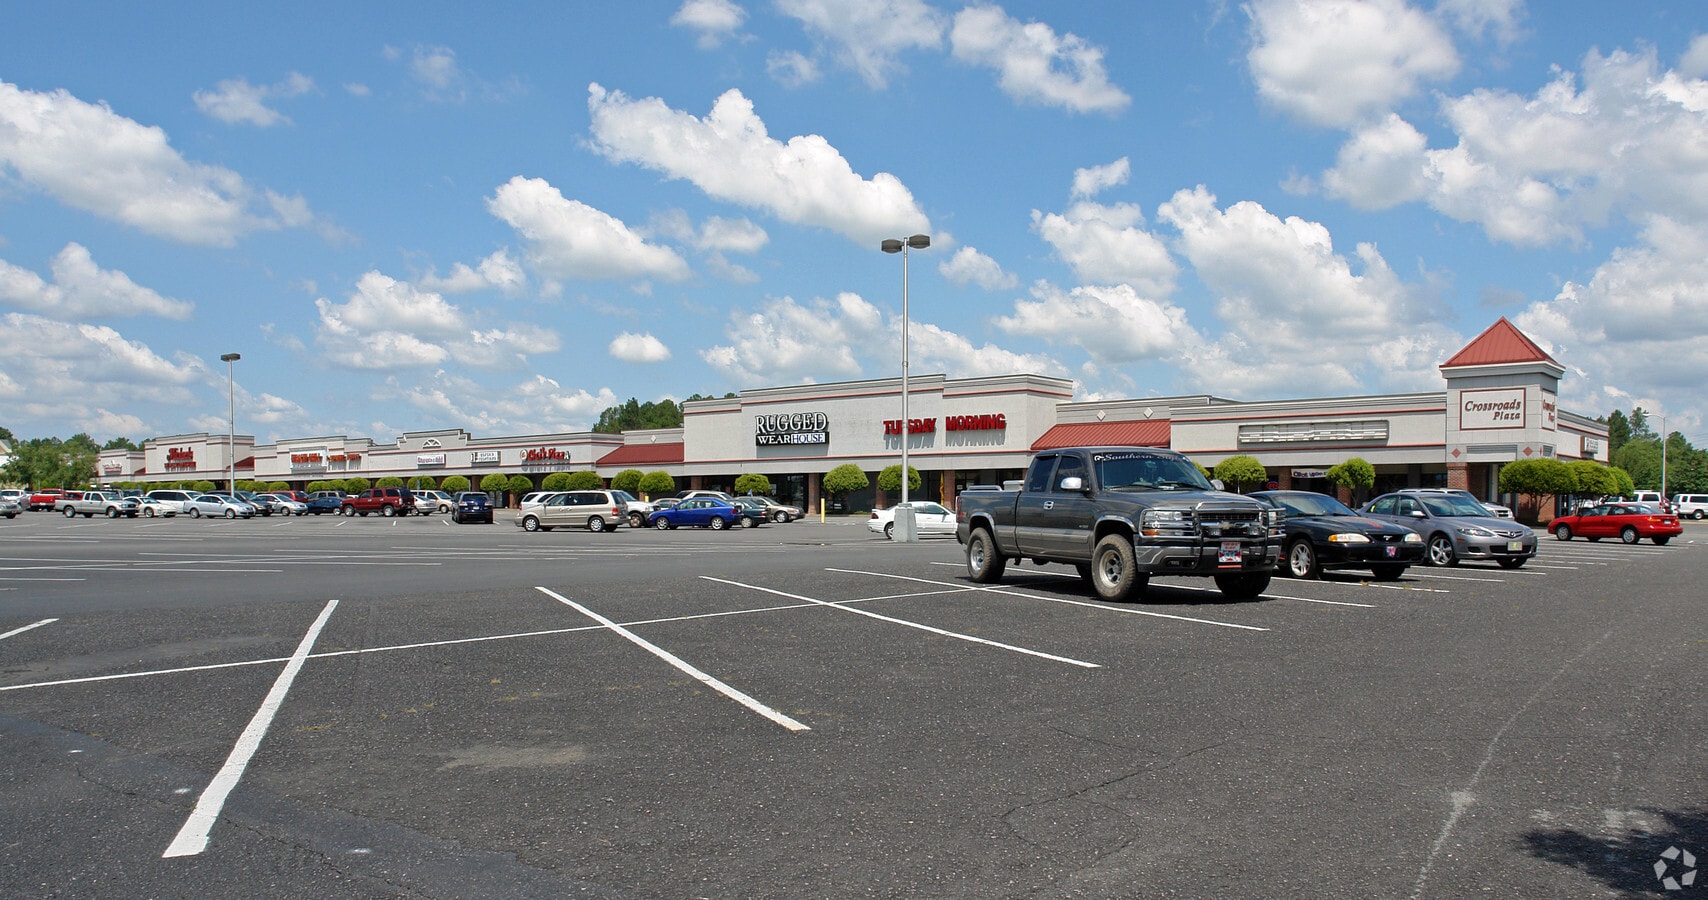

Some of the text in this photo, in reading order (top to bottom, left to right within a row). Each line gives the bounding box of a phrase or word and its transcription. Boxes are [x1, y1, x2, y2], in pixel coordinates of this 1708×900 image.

[1465, 399, 1521, 412] Crossroads
[756, 412, 829, 433] RUGGED
[1493, 411, 1521, 421] Plaza
[945, 414, 1006, 432] MORNING
[1104, 453, 1153, 461] Southern
